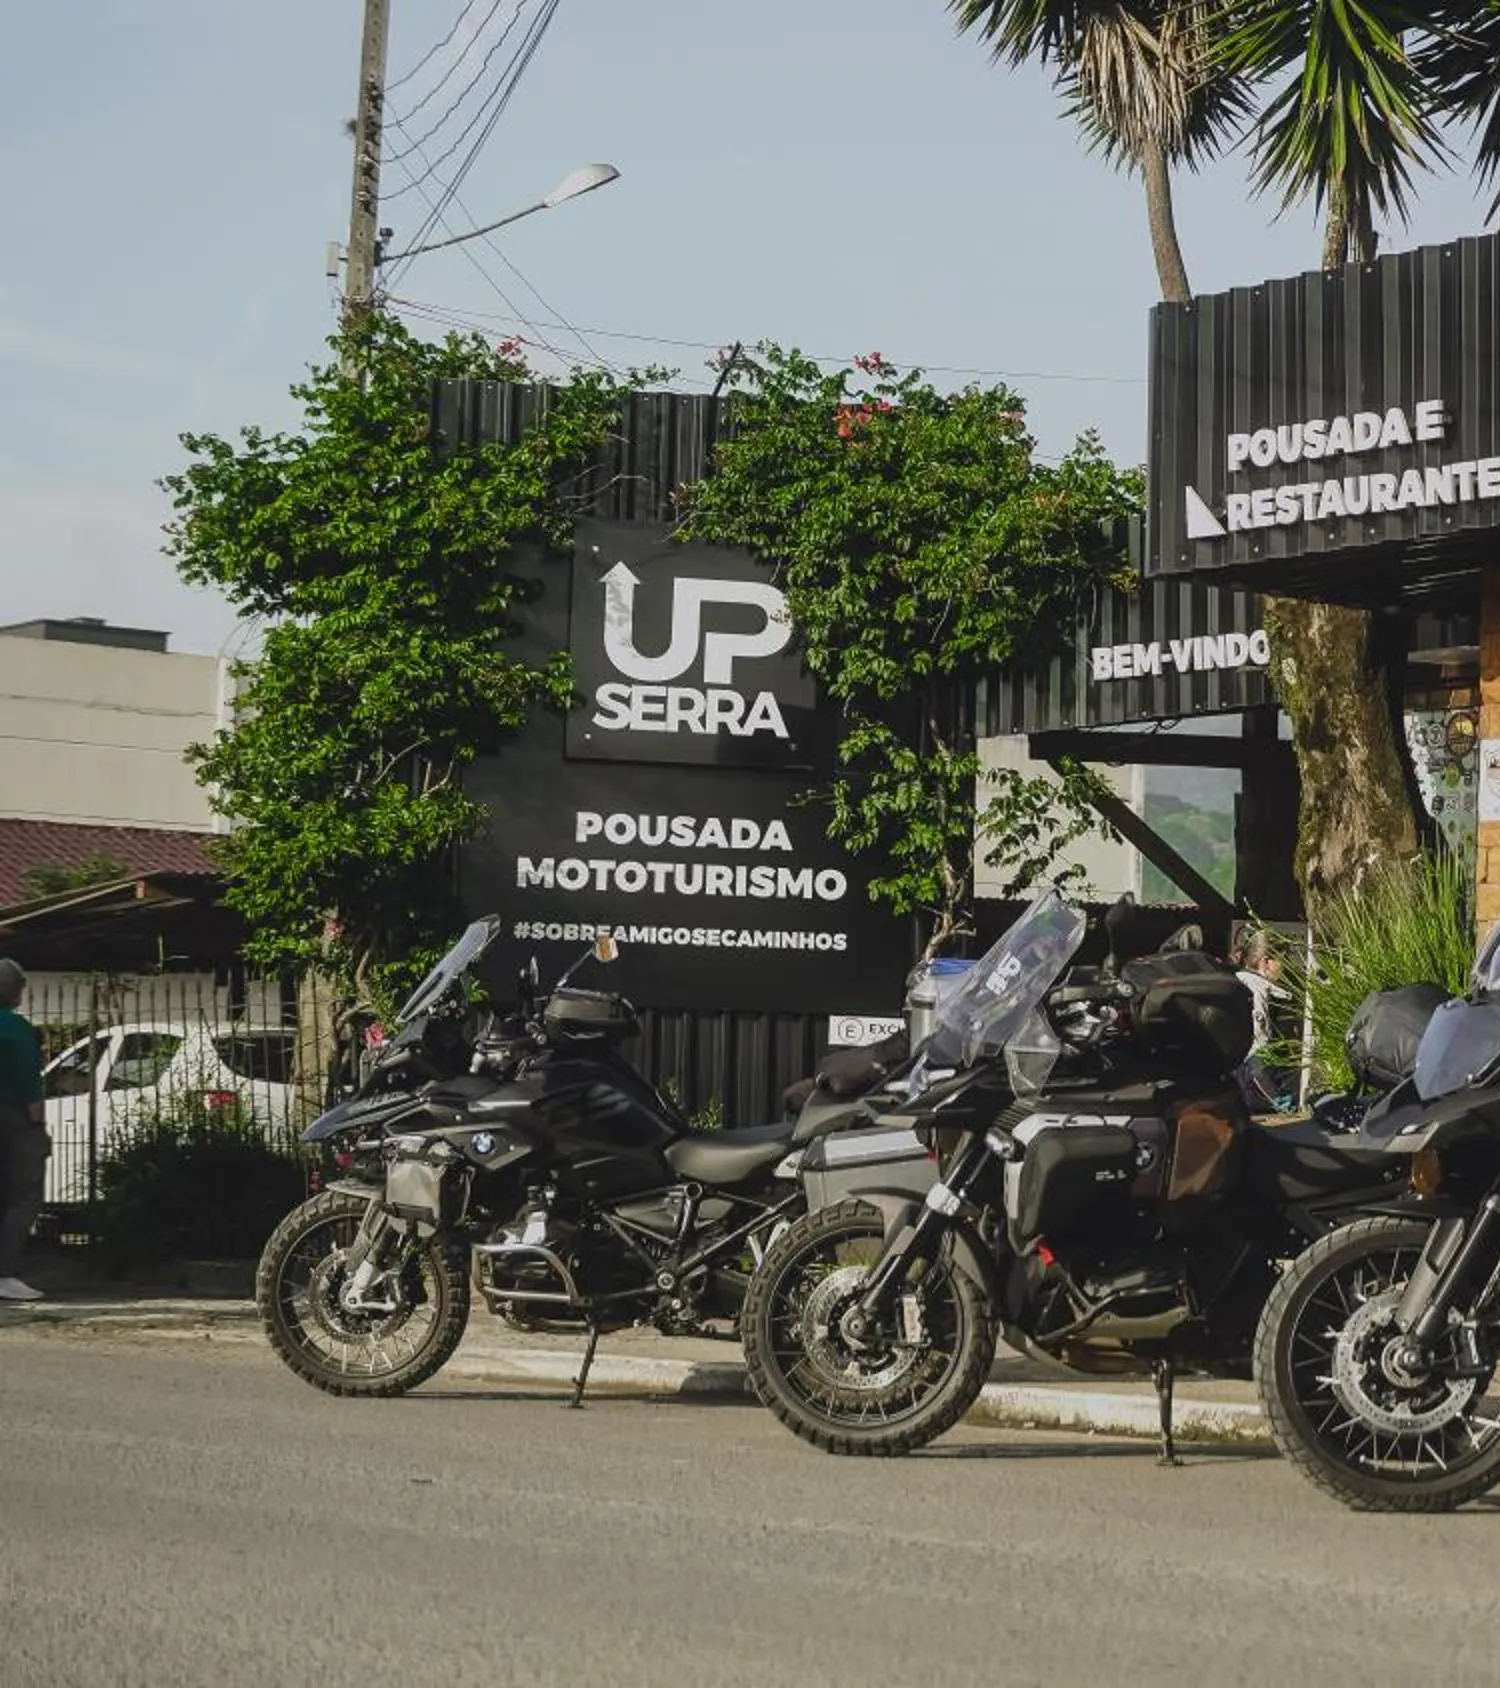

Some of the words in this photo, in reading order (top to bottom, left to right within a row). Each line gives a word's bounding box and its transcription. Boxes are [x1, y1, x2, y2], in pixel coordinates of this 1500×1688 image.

[1228, 407, 1412, 471] POUSADA
[1416, 400, 1444, 441] E
[600, 561, 793, 684] UP
[1092, 630, 1270, 681] BEM-VINDO
[592, 683, 789, 738] SERRA
[575, 812, 793, 851] POUSADA
[517, 857, 848, 900] MOTOTURISMO
[513, 922, 848, 951] #SOBREAMIGOSECAMINHOS
[869, 1023, 900, 1035] EXC
